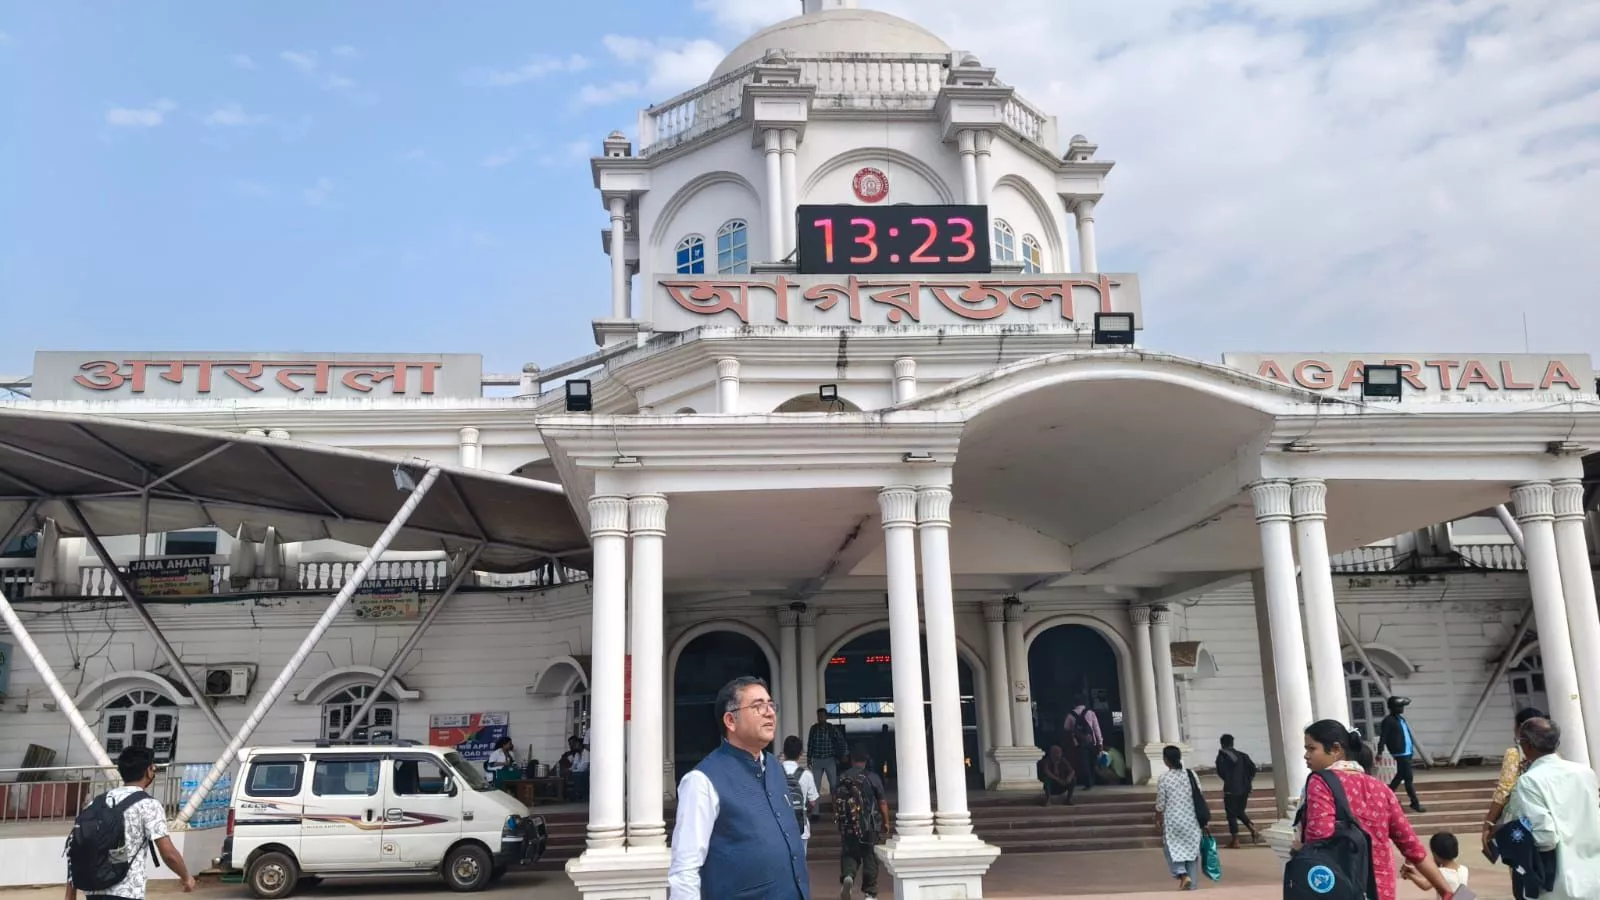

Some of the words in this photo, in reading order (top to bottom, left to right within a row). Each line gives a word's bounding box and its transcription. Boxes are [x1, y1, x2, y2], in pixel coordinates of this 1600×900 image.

[813, 217, 976, 264] 13:23
[658, 274, 1121, 324] আগরতলা
[73, 360, 442, 394] अगरतला
[1257, 359, 1581, 390] AGARTALA
[131, 560, 164, 571] JANA
[166, 558, 208, 569] AHAAR
[385, 578, 416, 588] AHAAR
